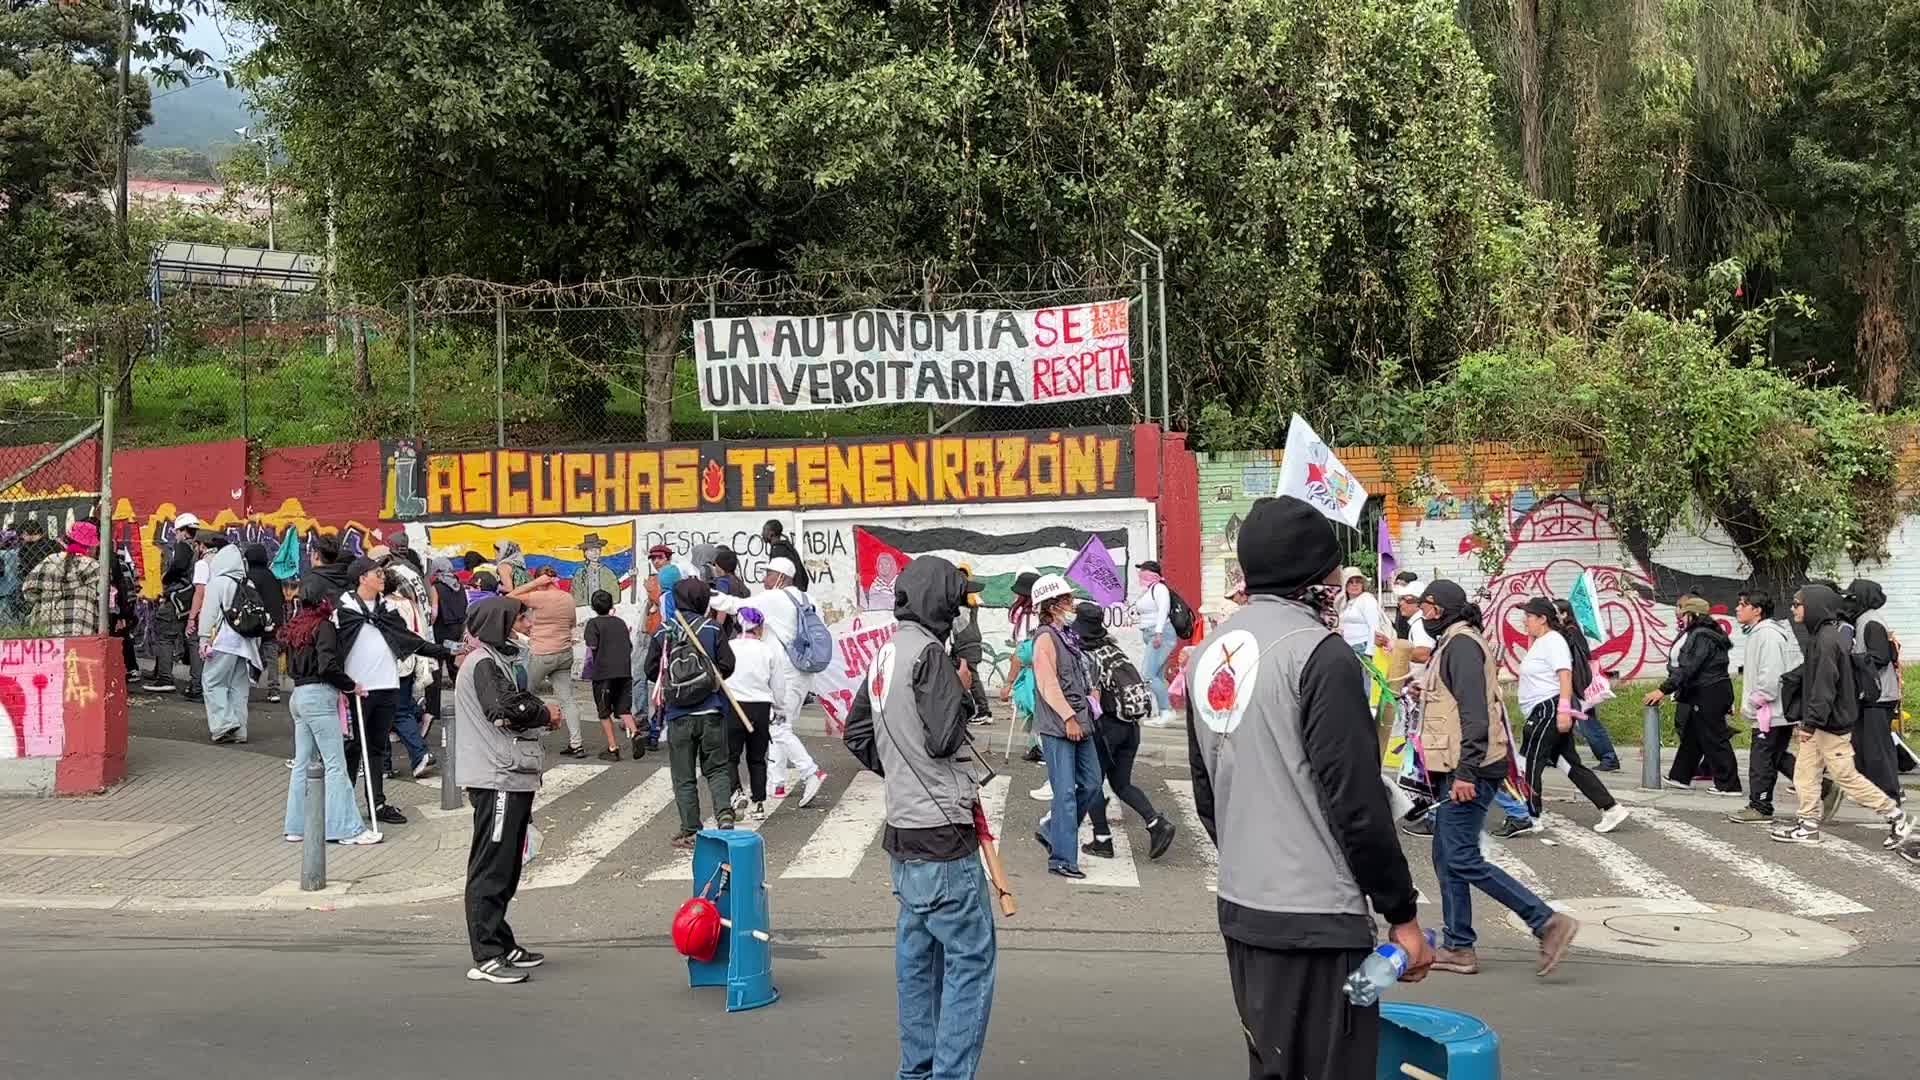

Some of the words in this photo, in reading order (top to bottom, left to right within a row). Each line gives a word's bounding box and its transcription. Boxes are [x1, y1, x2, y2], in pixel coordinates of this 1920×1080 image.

[703, 318, 760, 361] LA
[1034, 307, 1083, 348] SE
[705, 359, 1026, 407] UNIVERSITARIA
[1032, 348, 1132, 401] RESPETA
[497, 448, 700, 517] CUCHAS
[726, 442, 928, 507] TIENEN
[932, 434, 1121, 499] RAZÓN!
